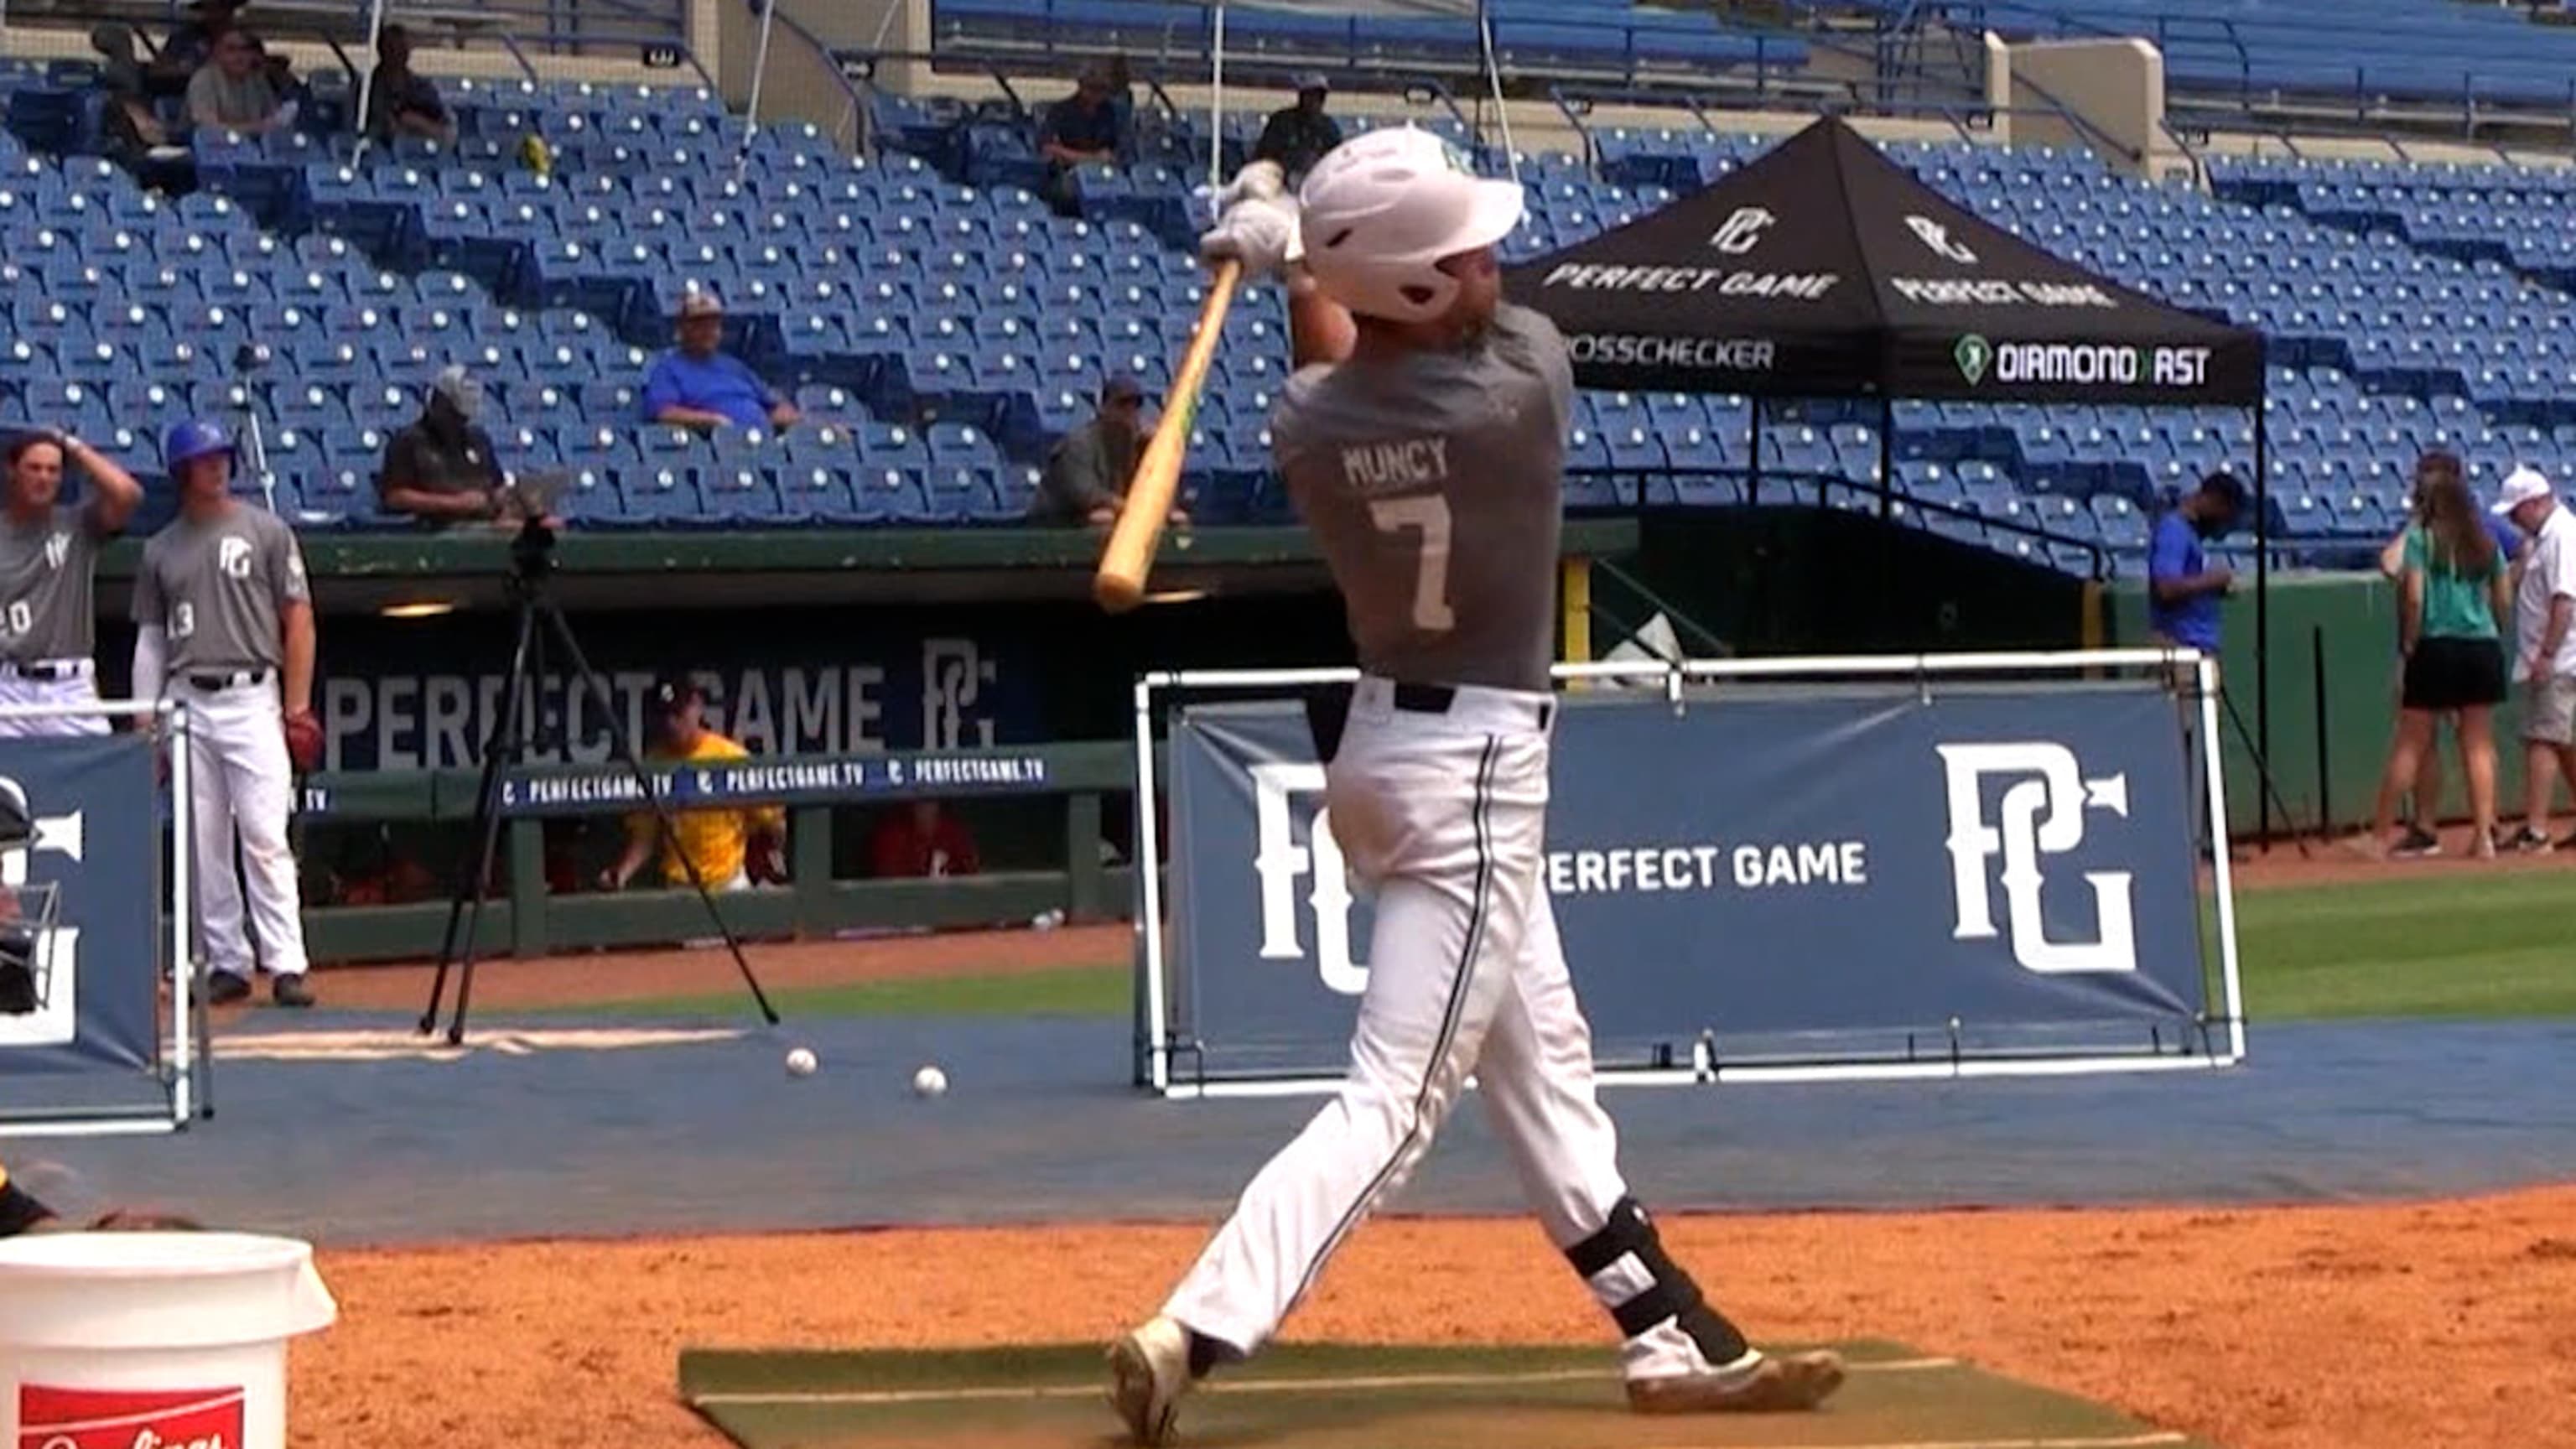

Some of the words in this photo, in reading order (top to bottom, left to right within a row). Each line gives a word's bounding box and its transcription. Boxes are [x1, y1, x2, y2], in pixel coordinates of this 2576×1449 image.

[1543, 262, 1720, 293] PERFECT
[1719, 271, 1839, 299] GAME
[1566, 335, 1776, 370] OSSCHECKER
[1342, 437, 1449, 486] MUNCY
[1367, 493, 1456, 631] 7
[1541, 846, 1717, 893] ERFECT
[1733, 842, 1867, 886] GAME
[1935, 742, 2137, 974] PG
